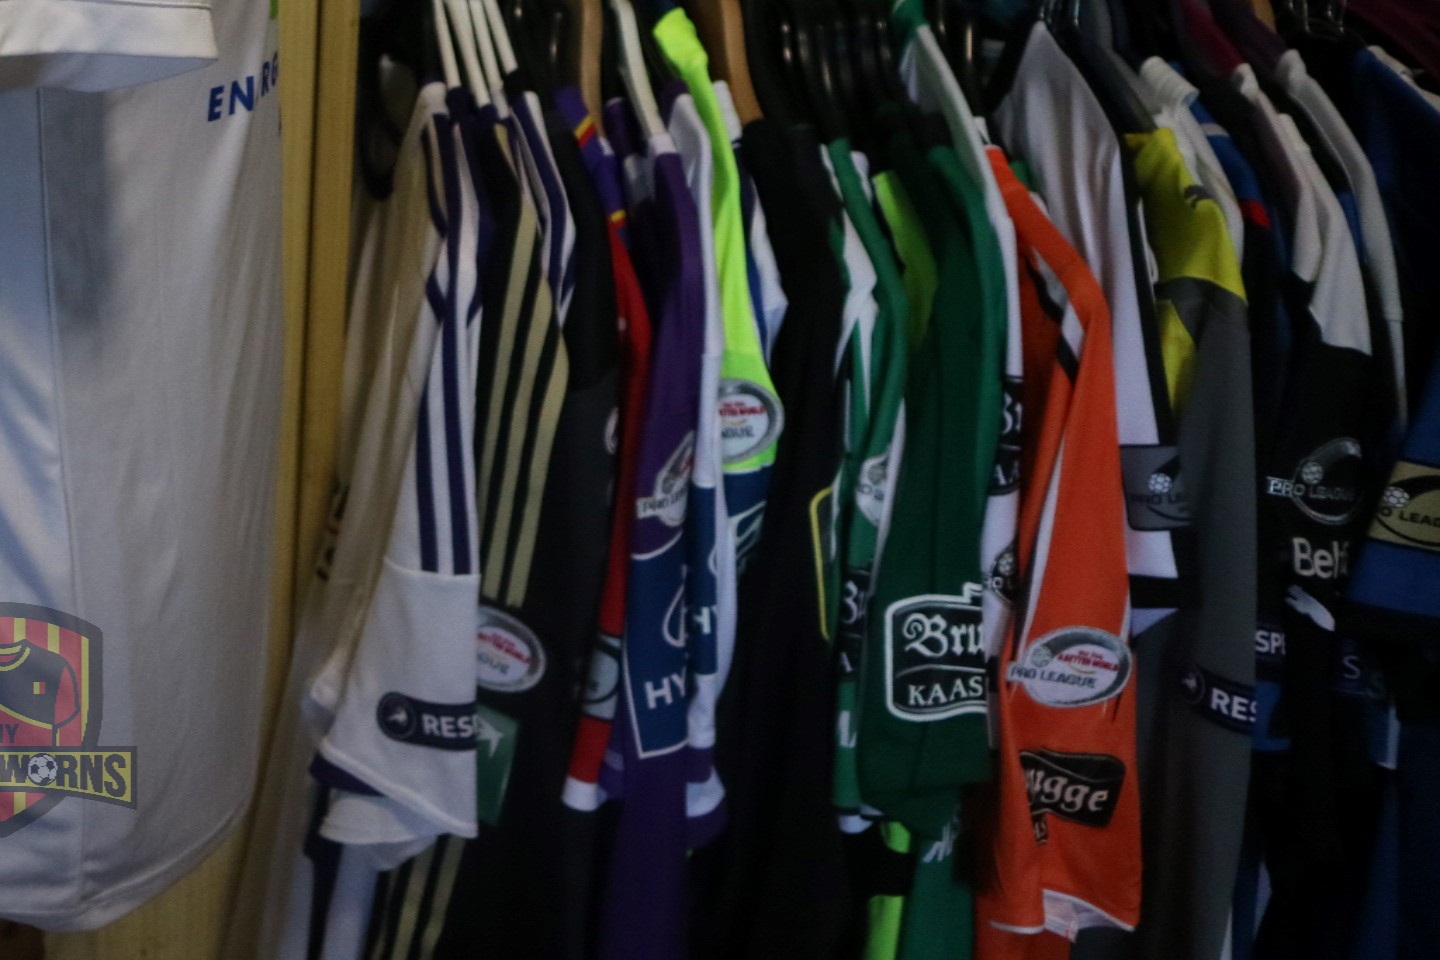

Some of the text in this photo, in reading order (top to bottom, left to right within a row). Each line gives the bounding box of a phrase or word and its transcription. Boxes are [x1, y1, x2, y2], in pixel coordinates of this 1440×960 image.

[1010, 665, 1098, 689] PRO LEAGUE
[421, 712, 478, 739] RES
